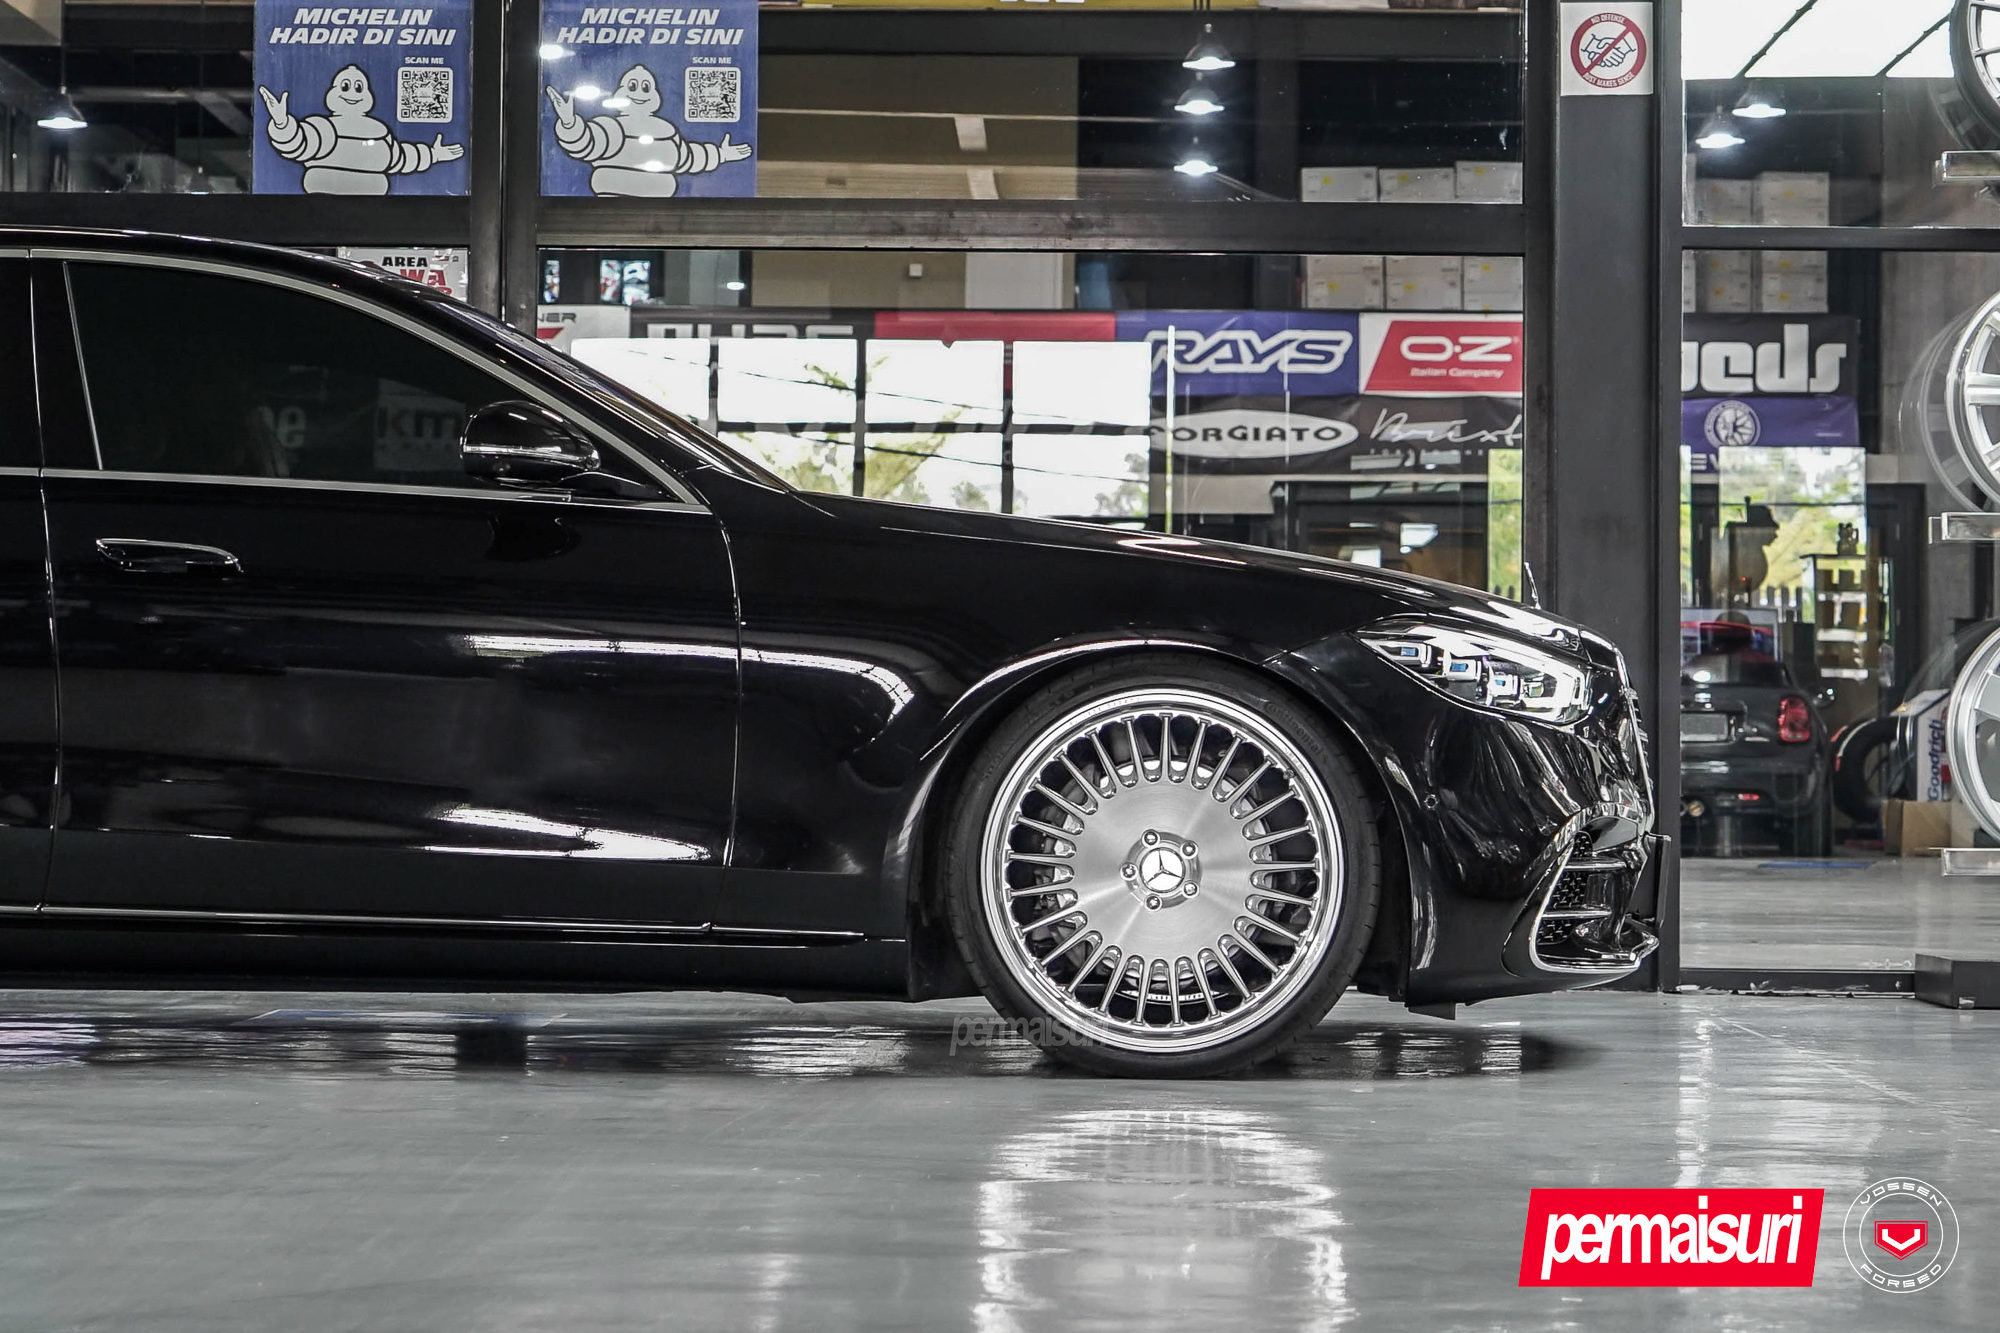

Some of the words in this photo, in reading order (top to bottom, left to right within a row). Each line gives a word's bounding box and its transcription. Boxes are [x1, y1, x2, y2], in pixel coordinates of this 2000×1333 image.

[293, 8, 433, 26] MICHELIN
[580, 8, 720, 26] MICHELIN
[269, 27, 359, 46] HADIR
[362, 28, 394, 46] DI
[397, 28, 457, 46] SINI
[557, 27, 646, 46] HADIR
[649, 28, 681, 46] DI
[684, 28, 745, 46] SINI
[405, 56, 428, 65] SCAN
[430, 56, 444, 65] ME
[692, 56, 716, 65] SCAN
[718, 56, 732, 65] ME
[382, 256, 428, 267] AREA
[1144, 330, 1353, 374] RAYS
[1448, 367, 1505, 379] Company
